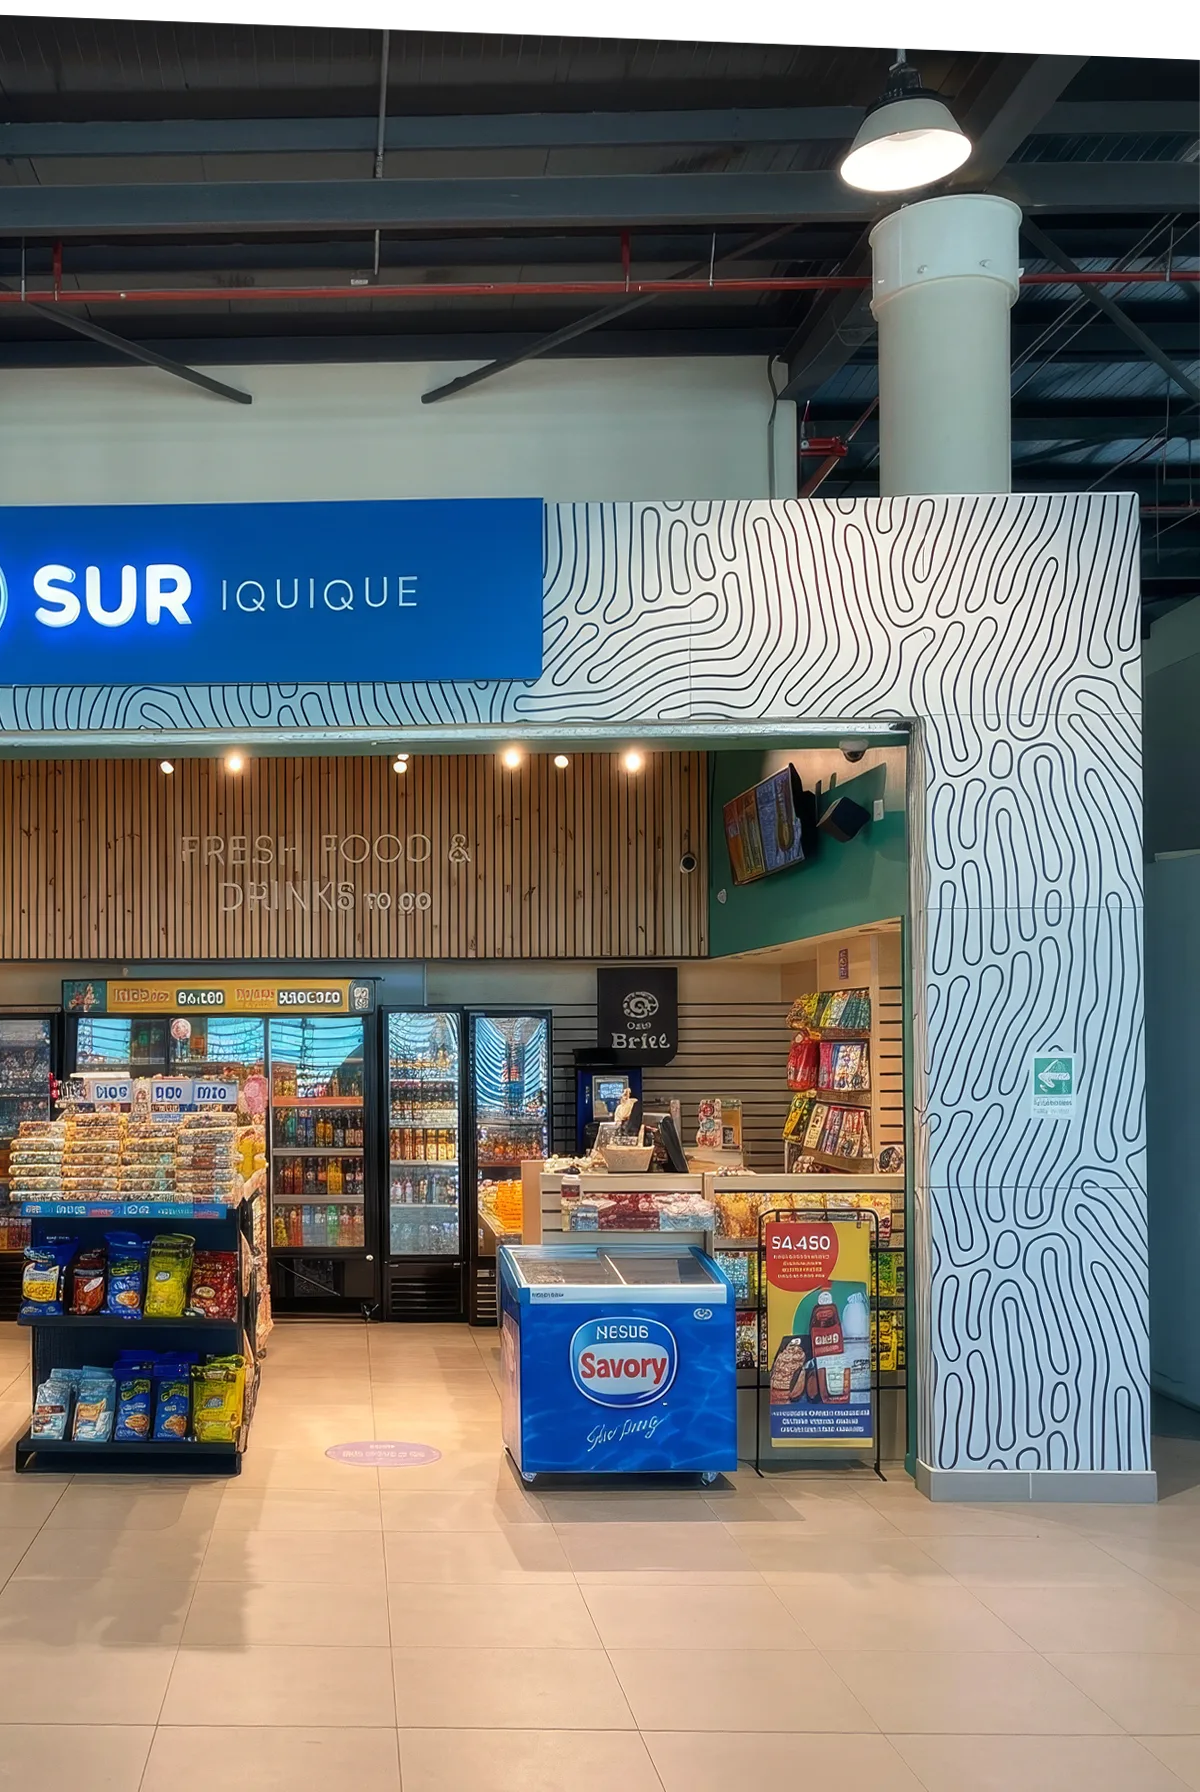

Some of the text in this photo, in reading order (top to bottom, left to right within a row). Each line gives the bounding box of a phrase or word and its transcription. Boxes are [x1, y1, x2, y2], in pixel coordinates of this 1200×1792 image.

[32, 563, 193, 629] SUR
[221, 575, 419, 613] IQUIQUE
[321, 833, 433, 864] FOOD
[220, 880, 356, 913] DRINKS
[580, 1352, 668, 1385] Savory
